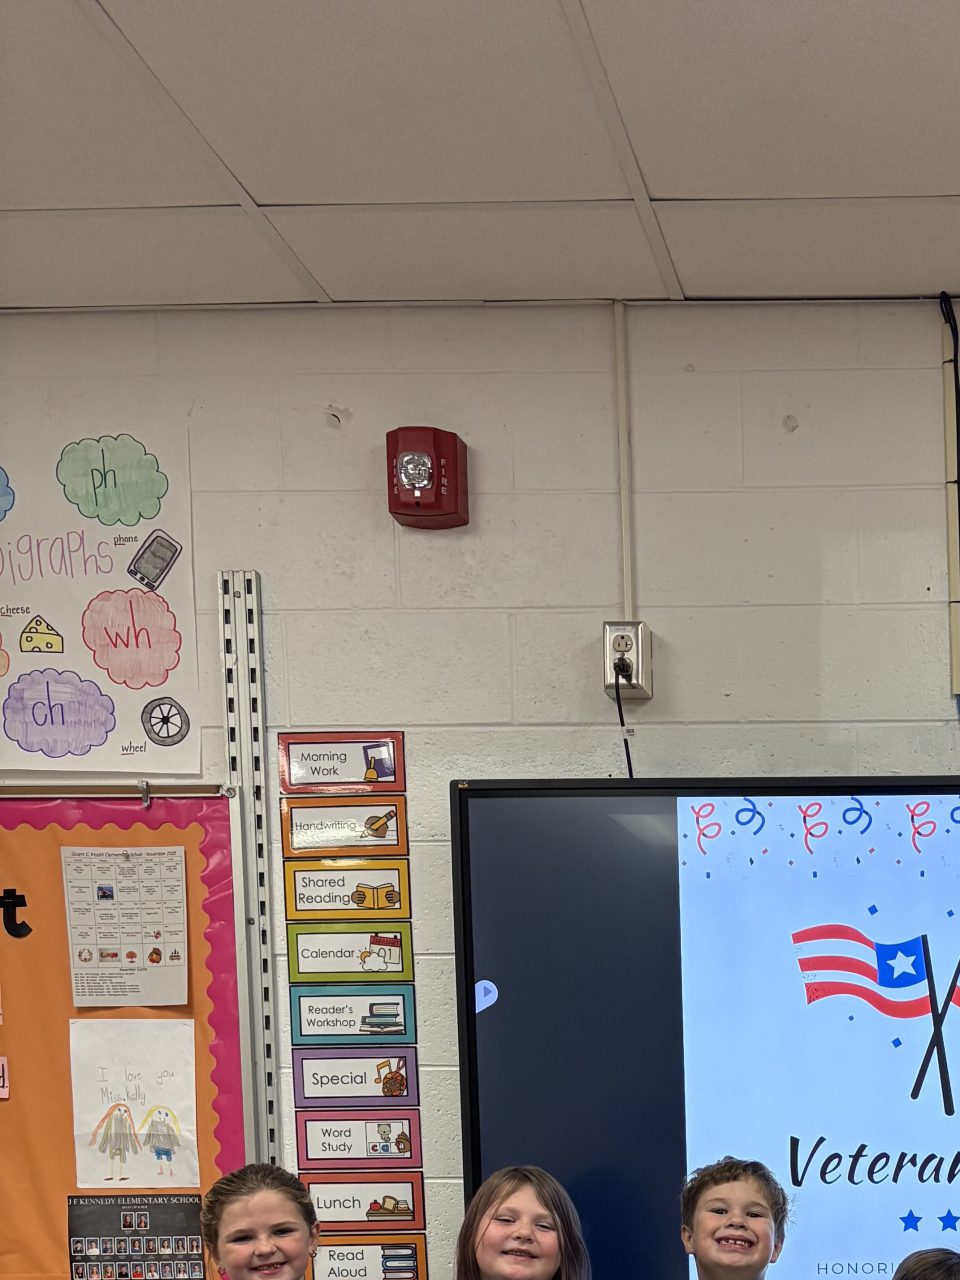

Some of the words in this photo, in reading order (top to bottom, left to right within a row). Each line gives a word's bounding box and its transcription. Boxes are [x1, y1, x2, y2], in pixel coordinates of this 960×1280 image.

[91, 448, 116, 506] ph
[113, 534, 139, 547] phone
[104, 600, 151, 649] wh
[32, 681, 65, 726] ch
[121, 744, 147, 756] wheel
[301, 752, 347, 767] Morning
[310, 766, 339, 777] Work
[295, 820, 356, 833] Handwriting
[301, 876, 345, 888] Shared
[298, 892, 350, 905] Reading
[301, 947, 354, 960] Calendar
[308, 1005, 353, 1014] Reader's
[306, 1017, 356, 1027] Workshop
[124, 1065, 141, 1082] love
[311, 1071, 367, 1086] Special
[321, 1127, 351, 1138] Word
[321, 1141, 353, 1153] Study
[171, 1196, 200, 1204] SCHOOL
[316, 1195, 361, 1209] Lunch
[328, 1251, 364, 1260] Read
[328, 1267, 367, 1277] Aloud
[817, 1262, 894, 1274] HONORI
